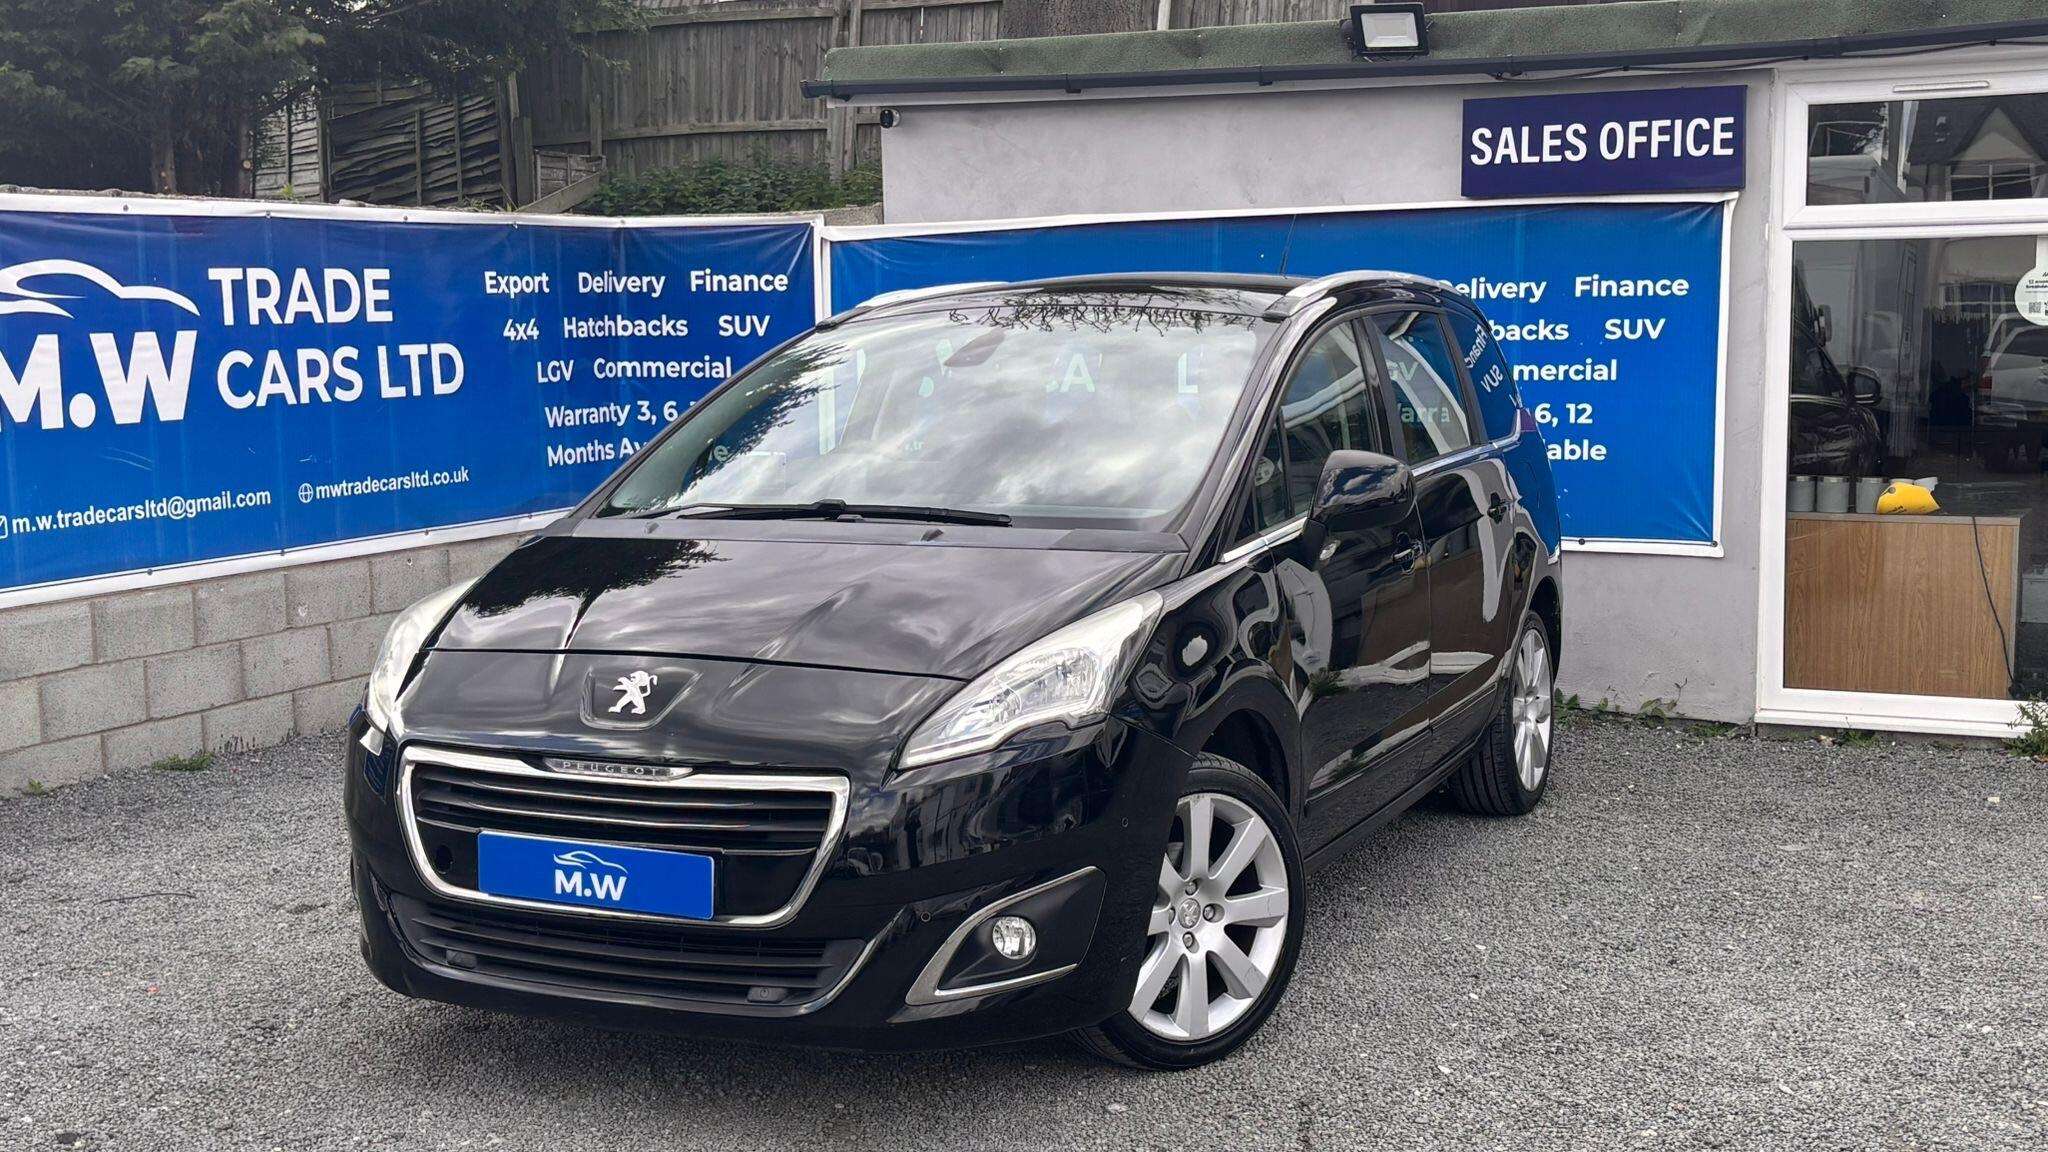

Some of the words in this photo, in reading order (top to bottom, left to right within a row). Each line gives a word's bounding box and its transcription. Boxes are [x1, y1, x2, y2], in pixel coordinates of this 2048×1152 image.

[1470, 122, 1588, 166] SALES
[1599, 116, 1735, 161] OFFICE
[208, 267, 394, 326] TRADE
[484, 271, 550, 299] Export
[578, 271, 666, 298] Delivery
[690, 268, 789, 293] Finance
[1440, 276, 1547, 304] elivery
[1574, 273, 1690, 298] Finance
[503, 318, 540, 341] 4x4
[563, 314, 689, 339] Hatchbacks
[718, 314, 771, 338] SUV
[1489, 318, 1570, 341] backs
[1604, 317, 1666, 341] SUV
[0, 329, 198, 430] M.W
[217, 346, 364, 410] CARS
[377, 342, 465, 399] LTD
[537, 359, 574, 384] LGV
[593, 355, 732, 380] Commercial
[1512, 357, 1618, 382] mercial
[545, 402, 631, 429] Warranty
[636, 400, 658, 426] 3,
[1534, 402, 1559, 428] 6,
[1565, 402, 1594, 424] 12
[547, 440, 615, 467] Months
[1546, 438, 1608, 461] able
[315, 465, 470, 500] mwtradecarsltd.co.uk
[12, 489, 272, 535] m.w.tradecarsltd@gmail.com
[562, 761, 659, 777] PEUGEOT
[554, 868, 628, 902] M.W
